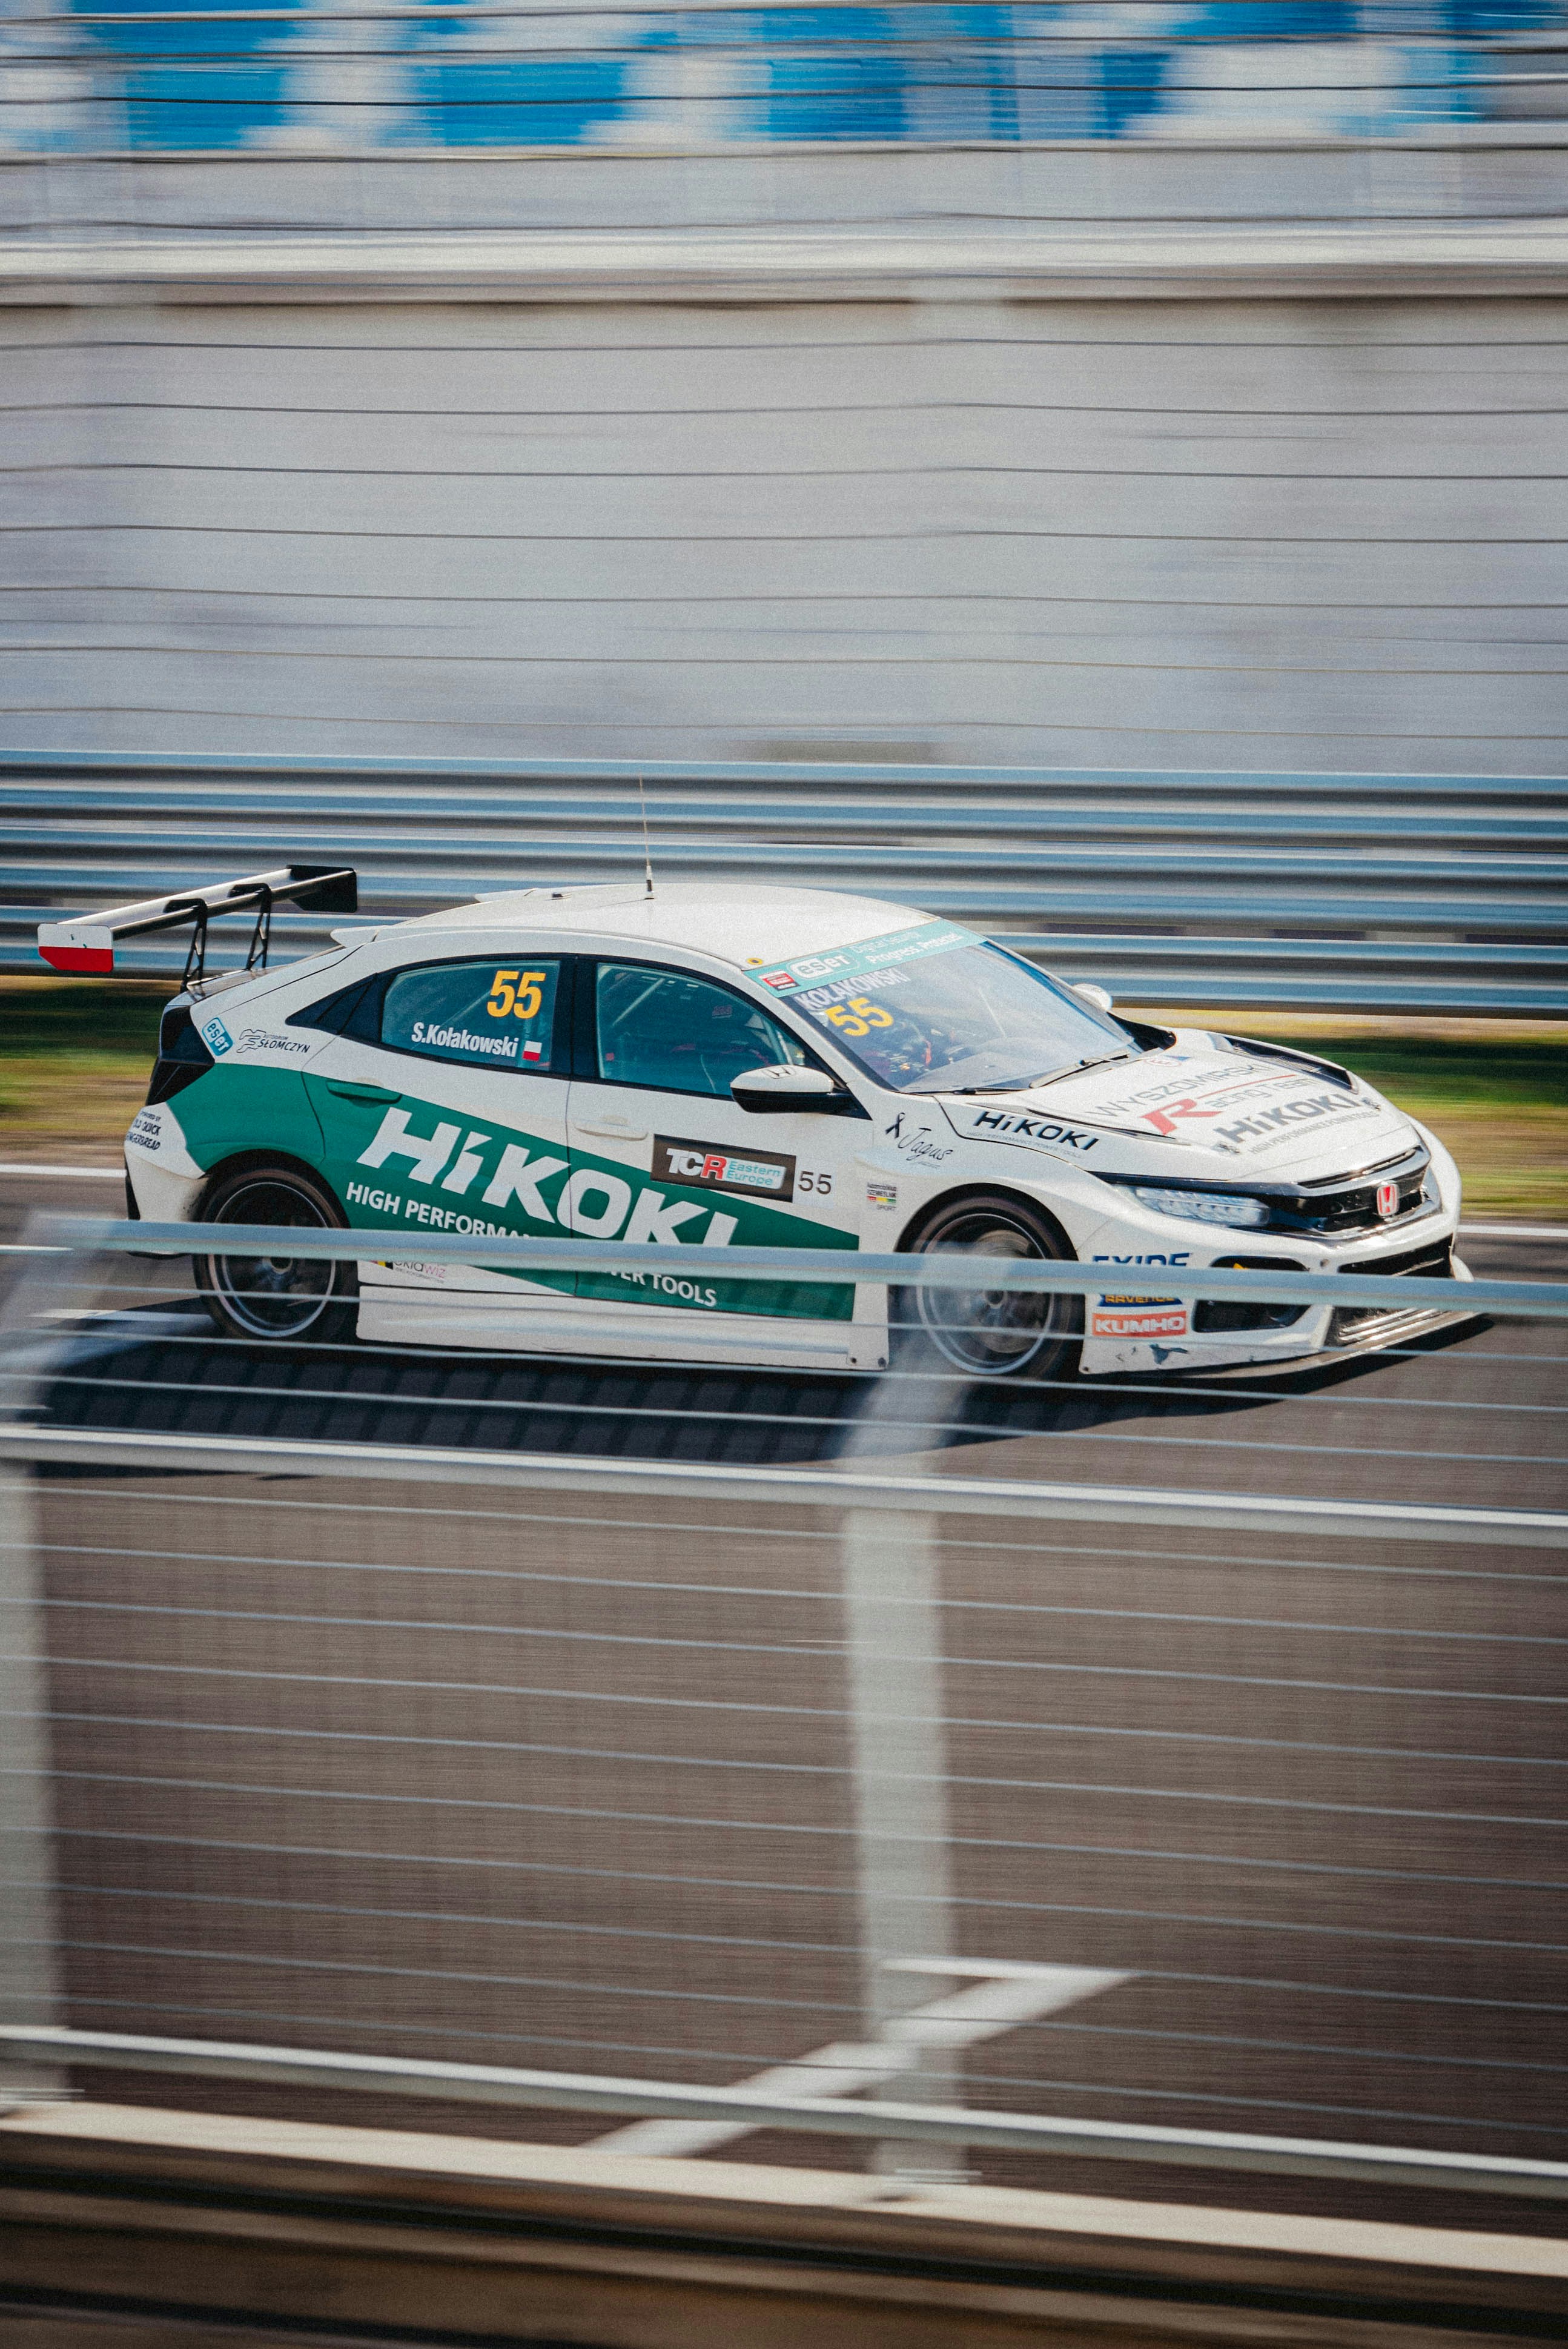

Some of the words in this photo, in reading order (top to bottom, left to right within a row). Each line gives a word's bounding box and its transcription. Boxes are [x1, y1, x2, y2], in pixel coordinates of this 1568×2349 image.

[487, 970, 546, 1019] 55
[824, 997, 894, 1036] 55
[257, 1038, 311, 1053] SŁOMCZYN
[411, 1022, 519, 1058] S.Kołakowski
[1085, 1062, 1273, 1117] WYSZOMIRSKI
[973, 1111, 1100, 1151] HiKOKI
[666, 1148, 727, 1180] TCR
[729, 1161, 781, 1178] Eastern
[727, 1170, 773, 1186] Europe
[798, 1171, 832, 1195] 55
[346, 1182, 401, 1215] HIGH
[405, 1199, 530, 1238] PERFORM
[652, 1273, 717, 1308] TOOLS
[1095, 1316, 1185, 1333] KUMHO
